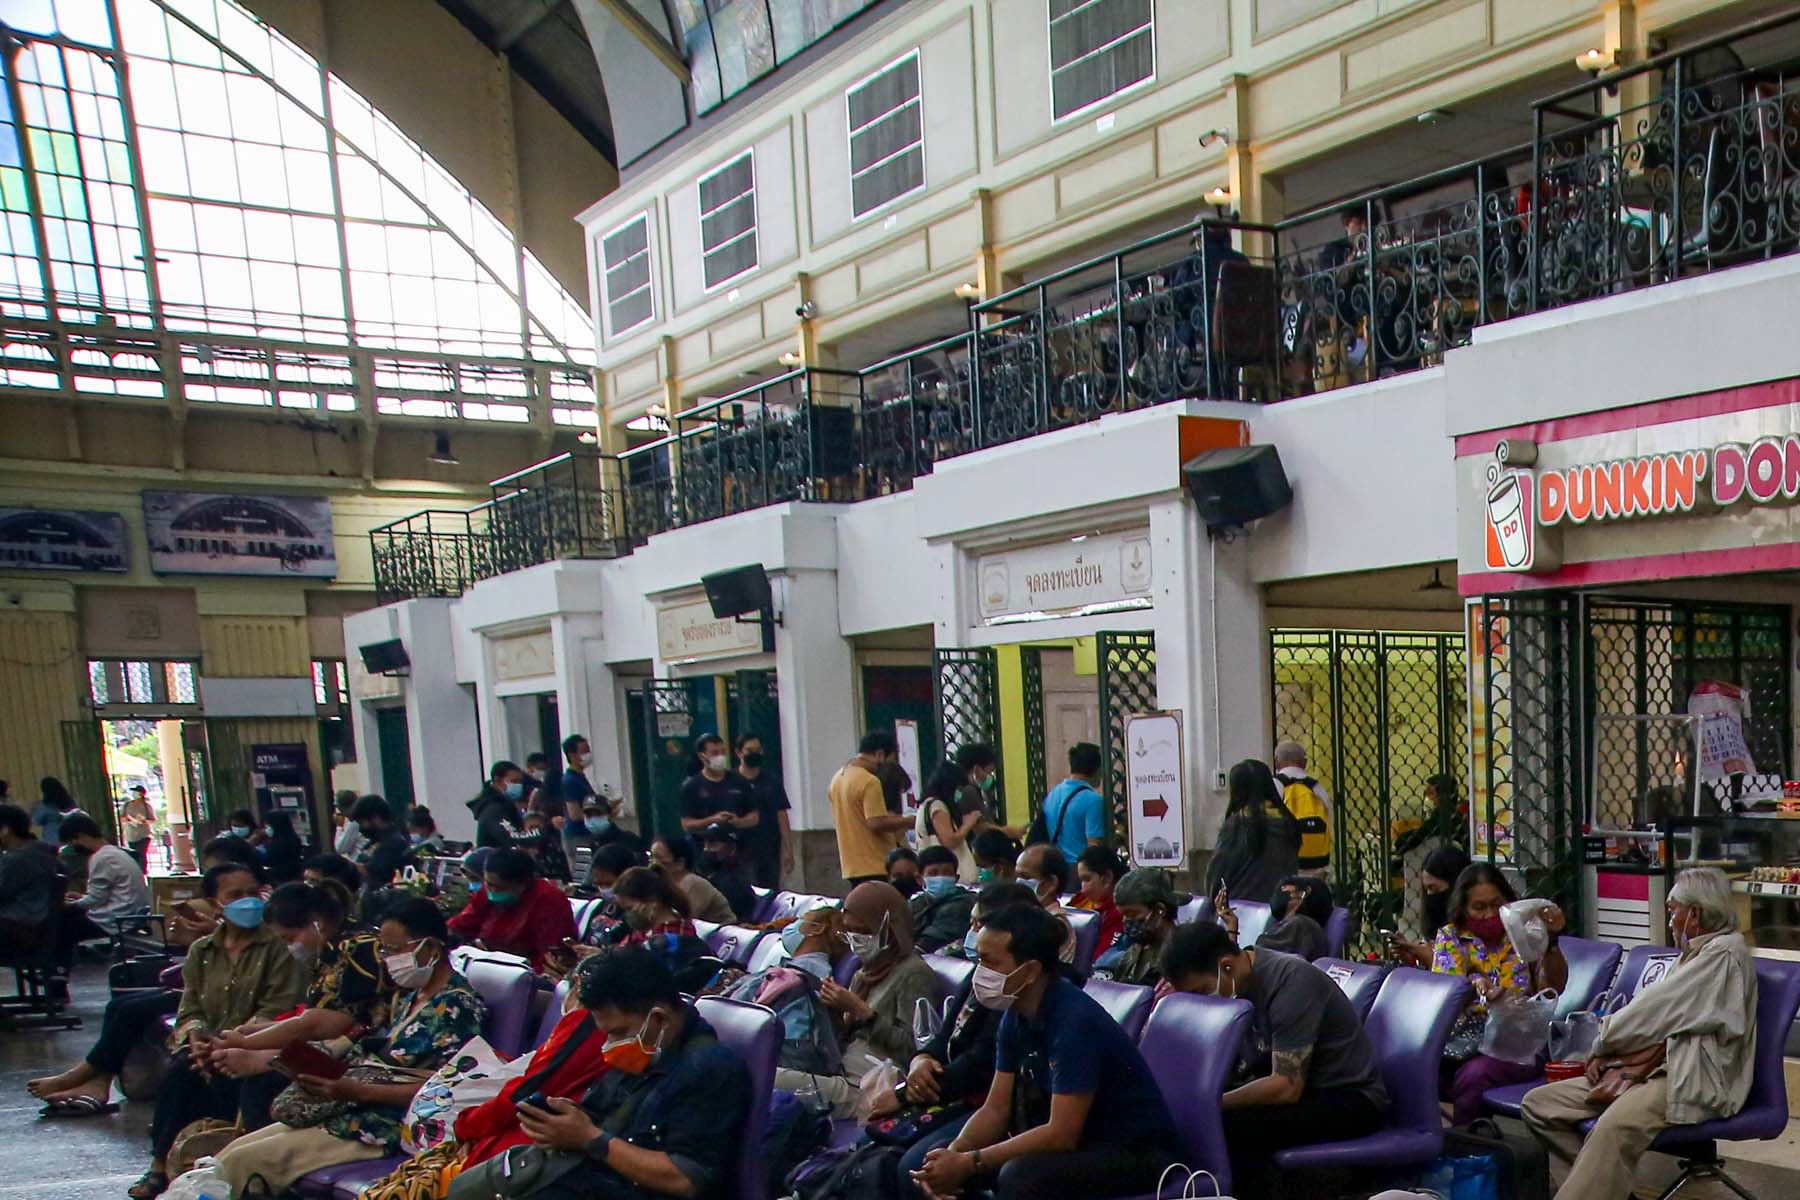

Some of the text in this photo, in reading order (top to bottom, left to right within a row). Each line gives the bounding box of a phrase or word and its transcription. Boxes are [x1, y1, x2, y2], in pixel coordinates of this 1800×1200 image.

[1540, 451, 1705, 526] DUNKIN'
[1503, 520, 1518, 538] DD
[1025, 554, 1102, 606] จุดลงทะเบียน
[256, 754, 279, 764] ATM
